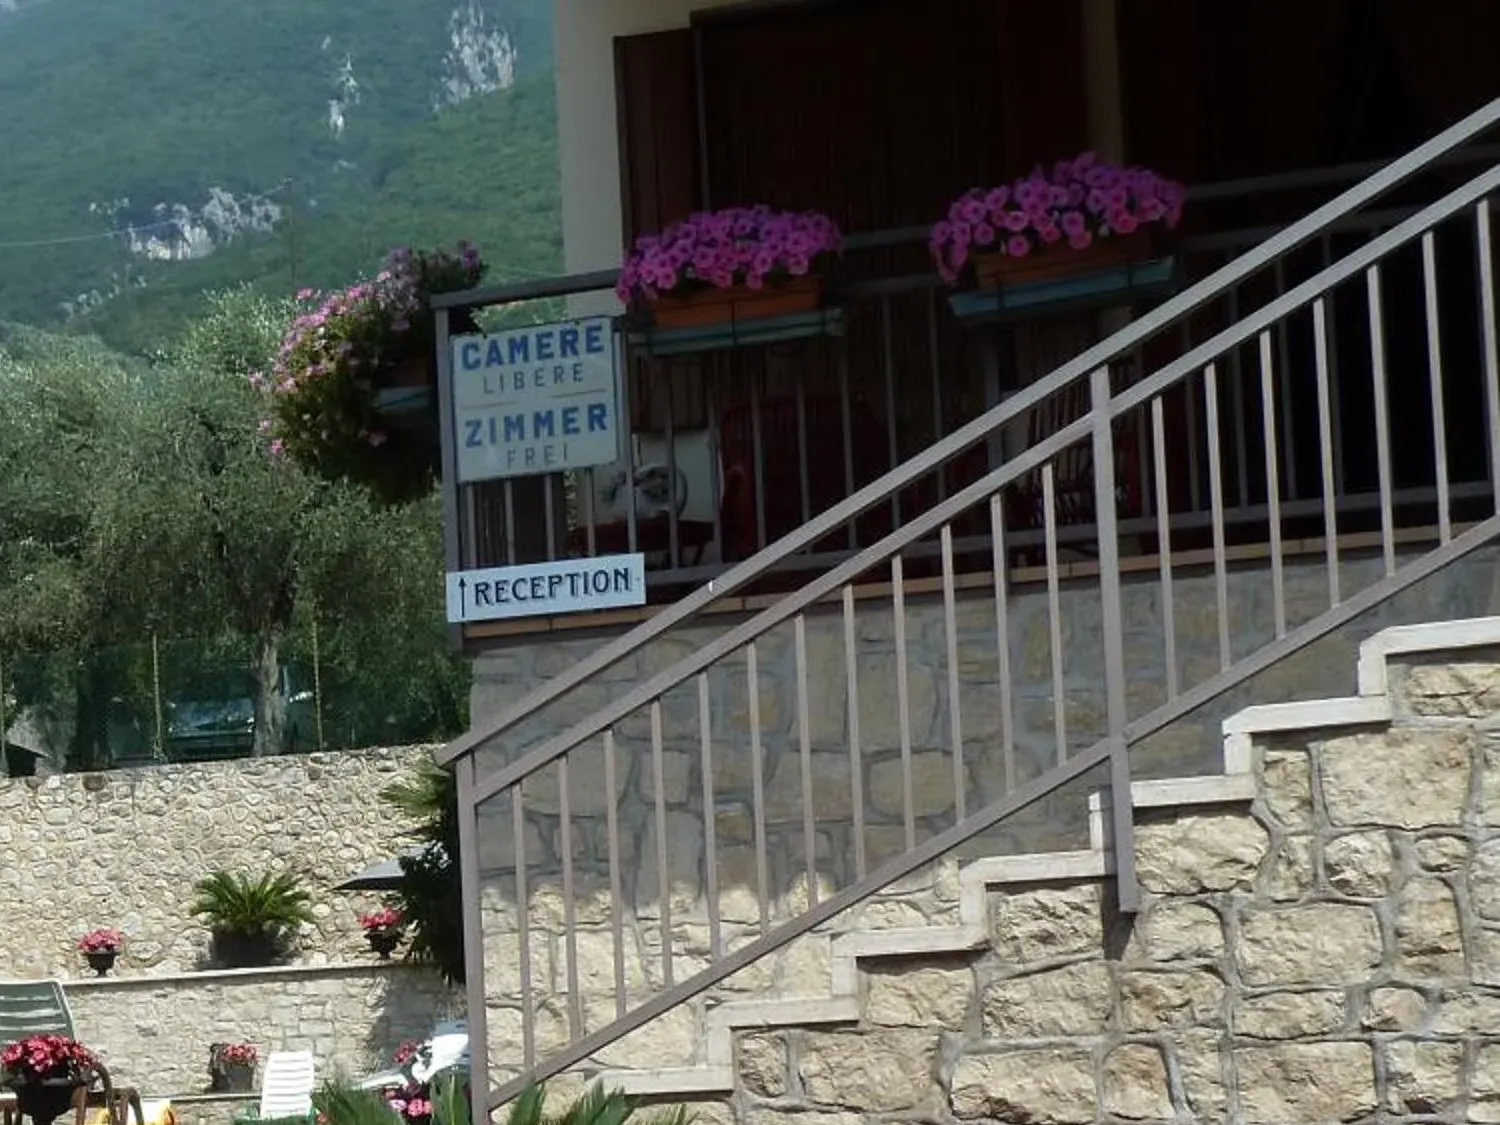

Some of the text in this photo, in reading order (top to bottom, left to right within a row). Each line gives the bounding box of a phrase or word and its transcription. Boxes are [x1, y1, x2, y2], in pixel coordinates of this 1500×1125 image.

[461, 325, 605, 370] CAMERE
[483, 362, 585, 395] LIBERE
[464, 402, 608, 449] ZIMMER
[505, 443, 569, 469] FREI
[474, 567, 632, 607] RECEPTION
